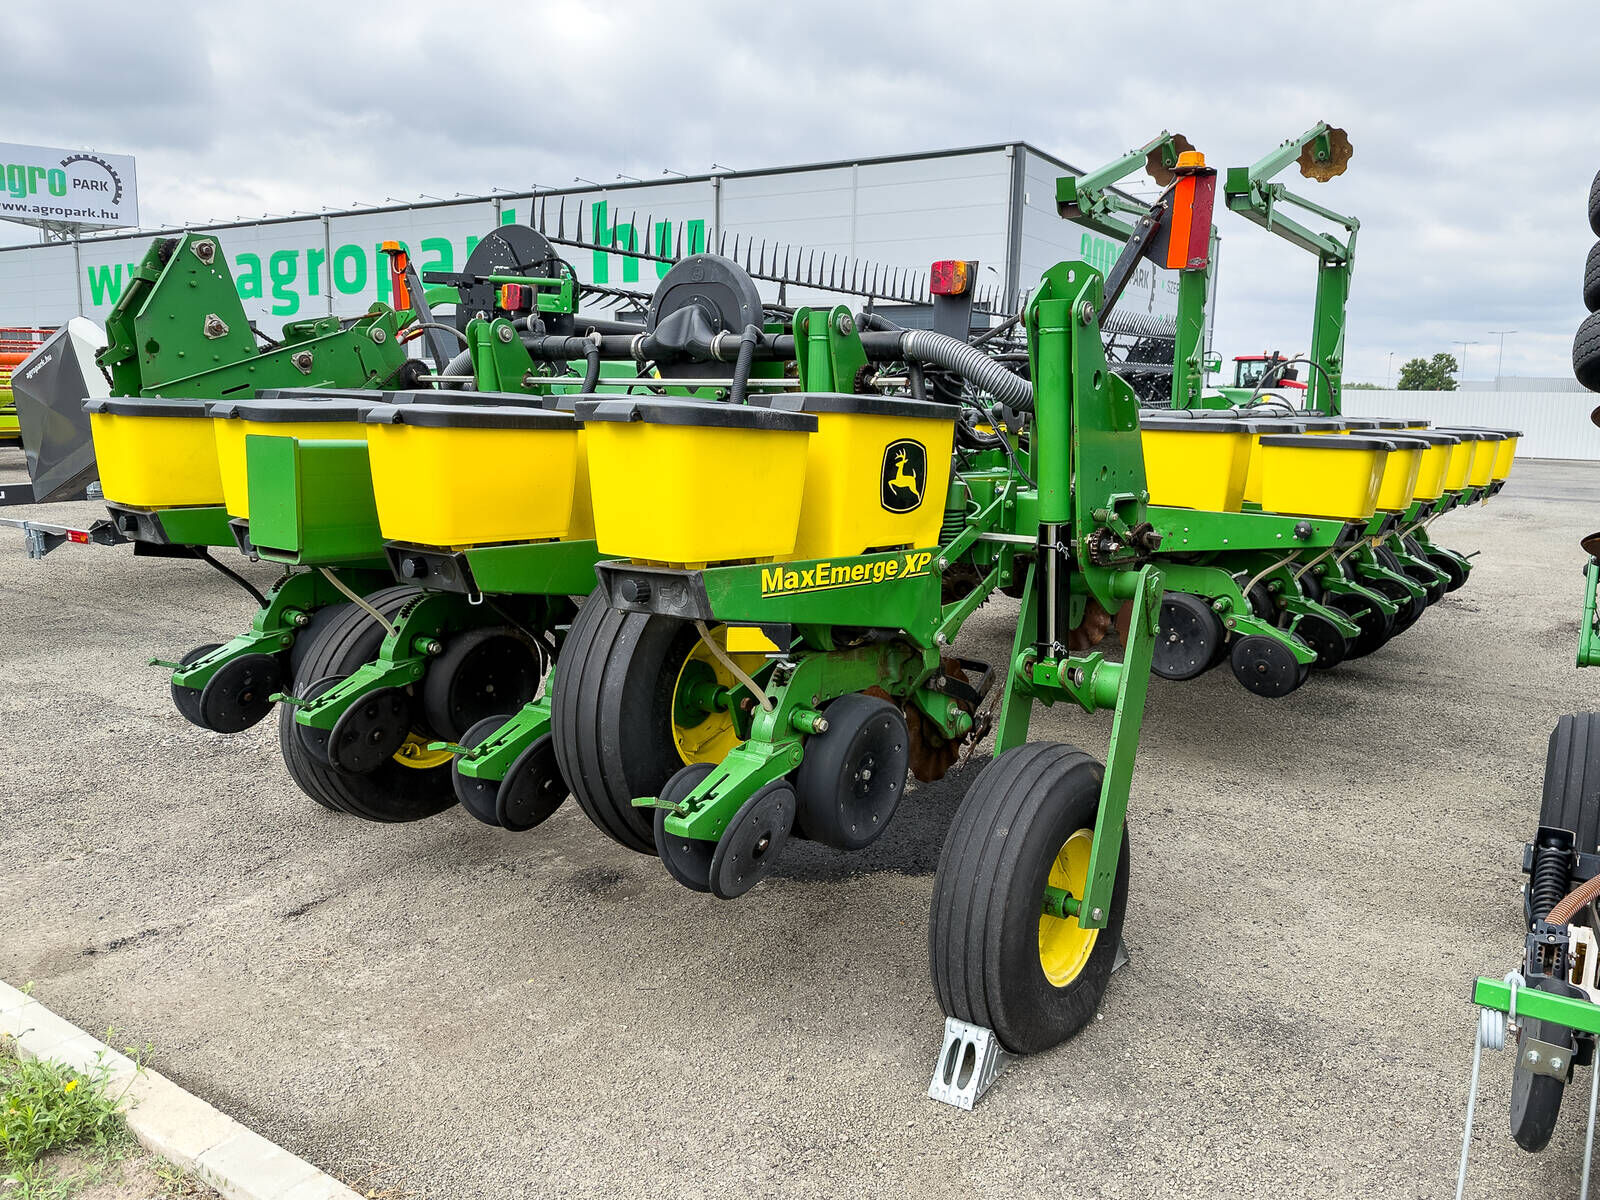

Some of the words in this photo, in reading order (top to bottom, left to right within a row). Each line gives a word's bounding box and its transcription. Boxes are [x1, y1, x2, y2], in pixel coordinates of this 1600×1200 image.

[73, 178, 109, 192] PARK
[0, 202, 119, 220] ww.agropark.hu
[761, 558, 898, 594] MaxEmerge
[897, 552, 932, 579] XP
